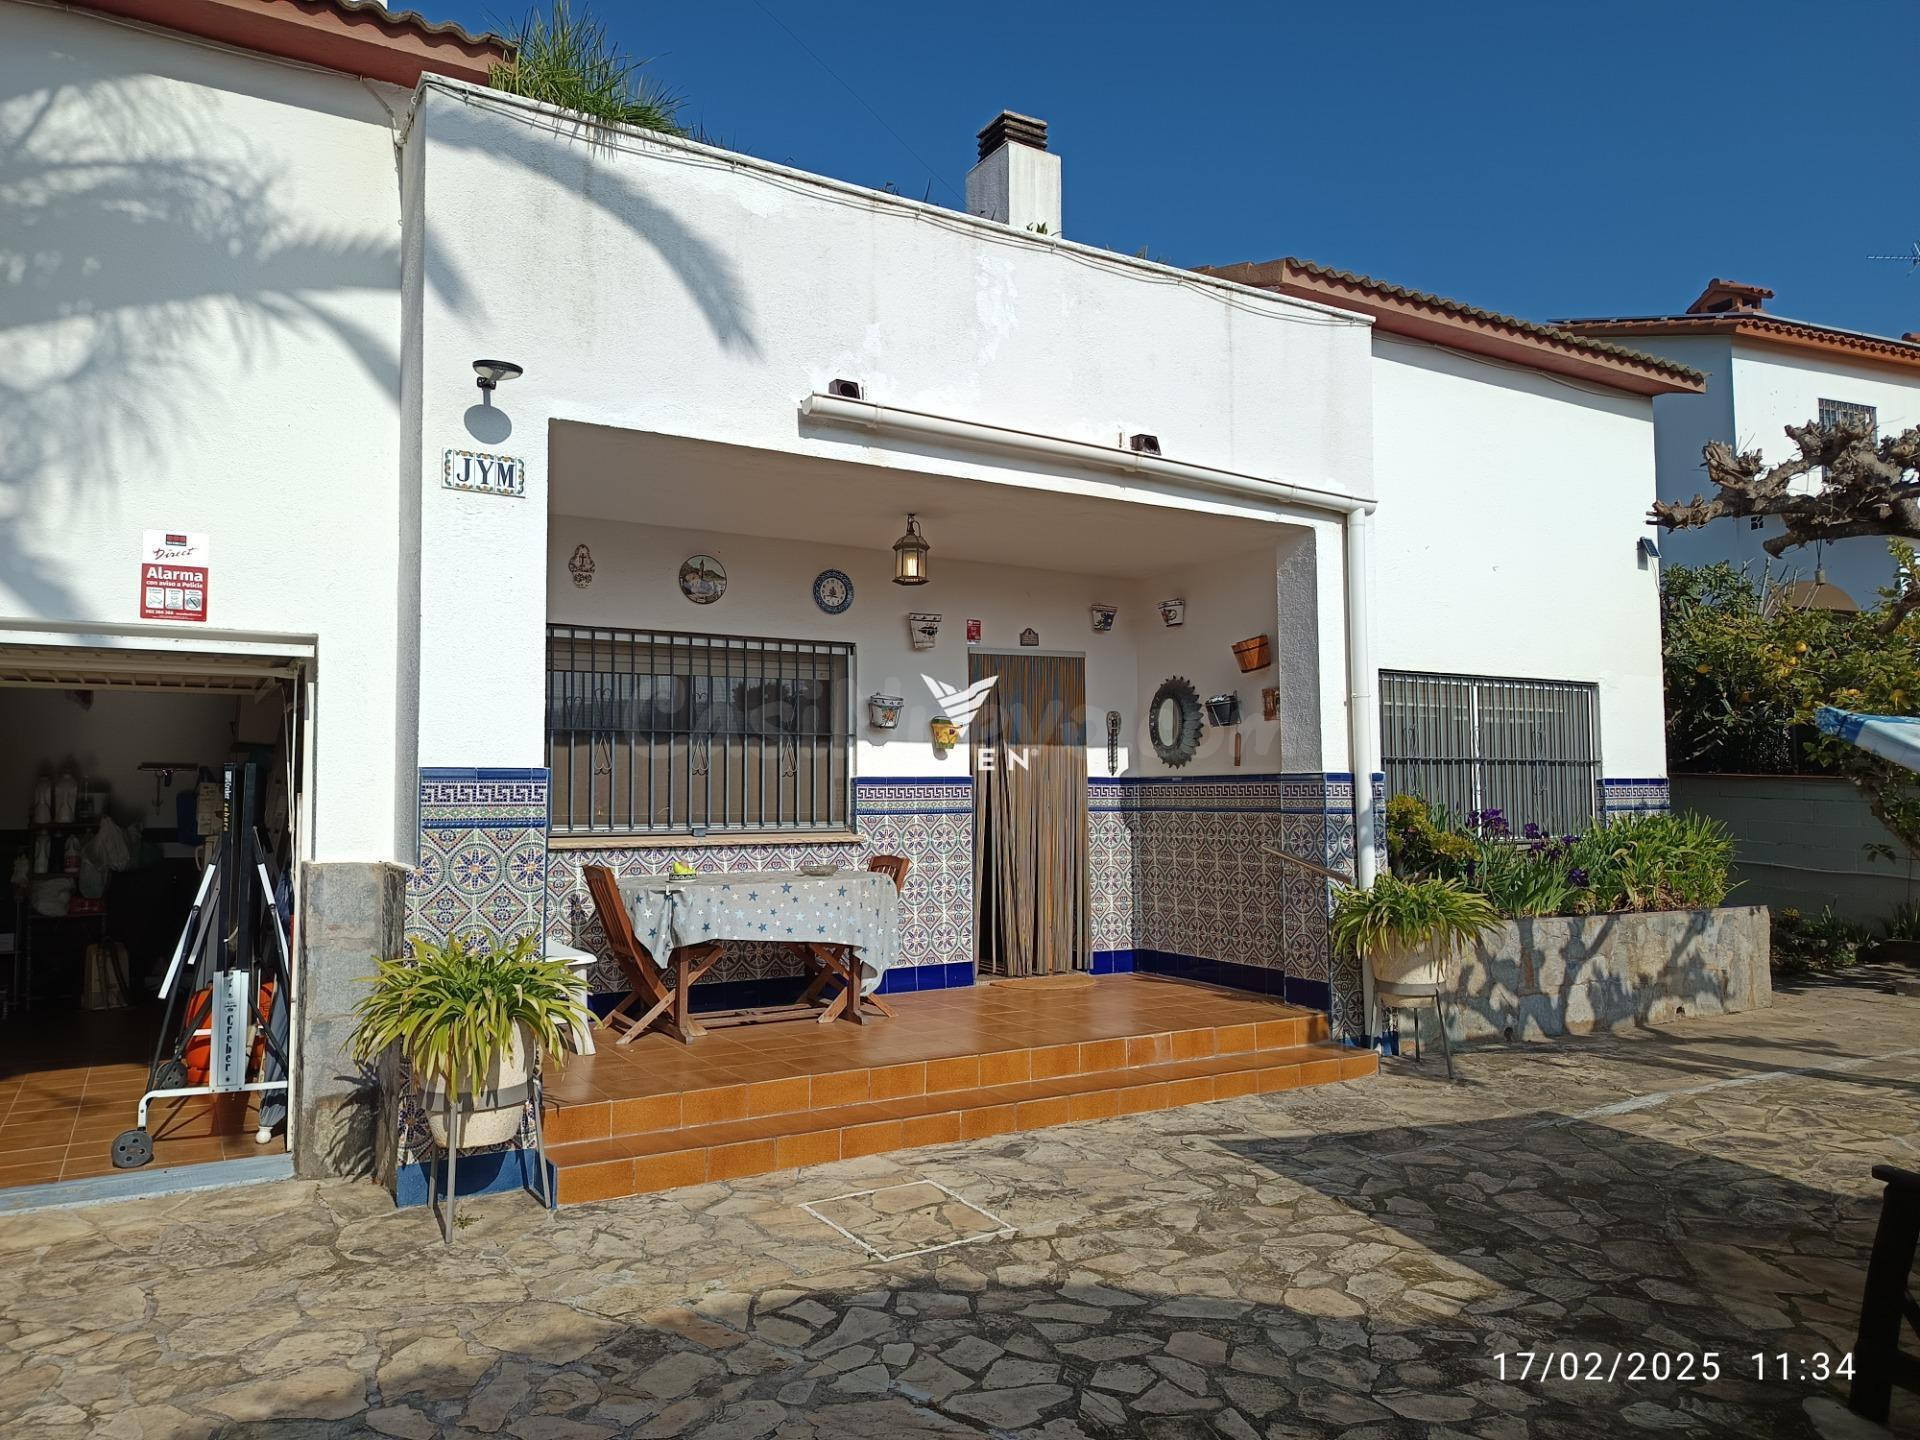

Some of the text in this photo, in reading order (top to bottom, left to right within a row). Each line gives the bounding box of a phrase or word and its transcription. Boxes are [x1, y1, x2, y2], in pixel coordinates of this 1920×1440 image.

[456, 458, 515, 488] JYM
[153, 547, 197, 560] Direct
[146, 567, 203, 582] Alarma
